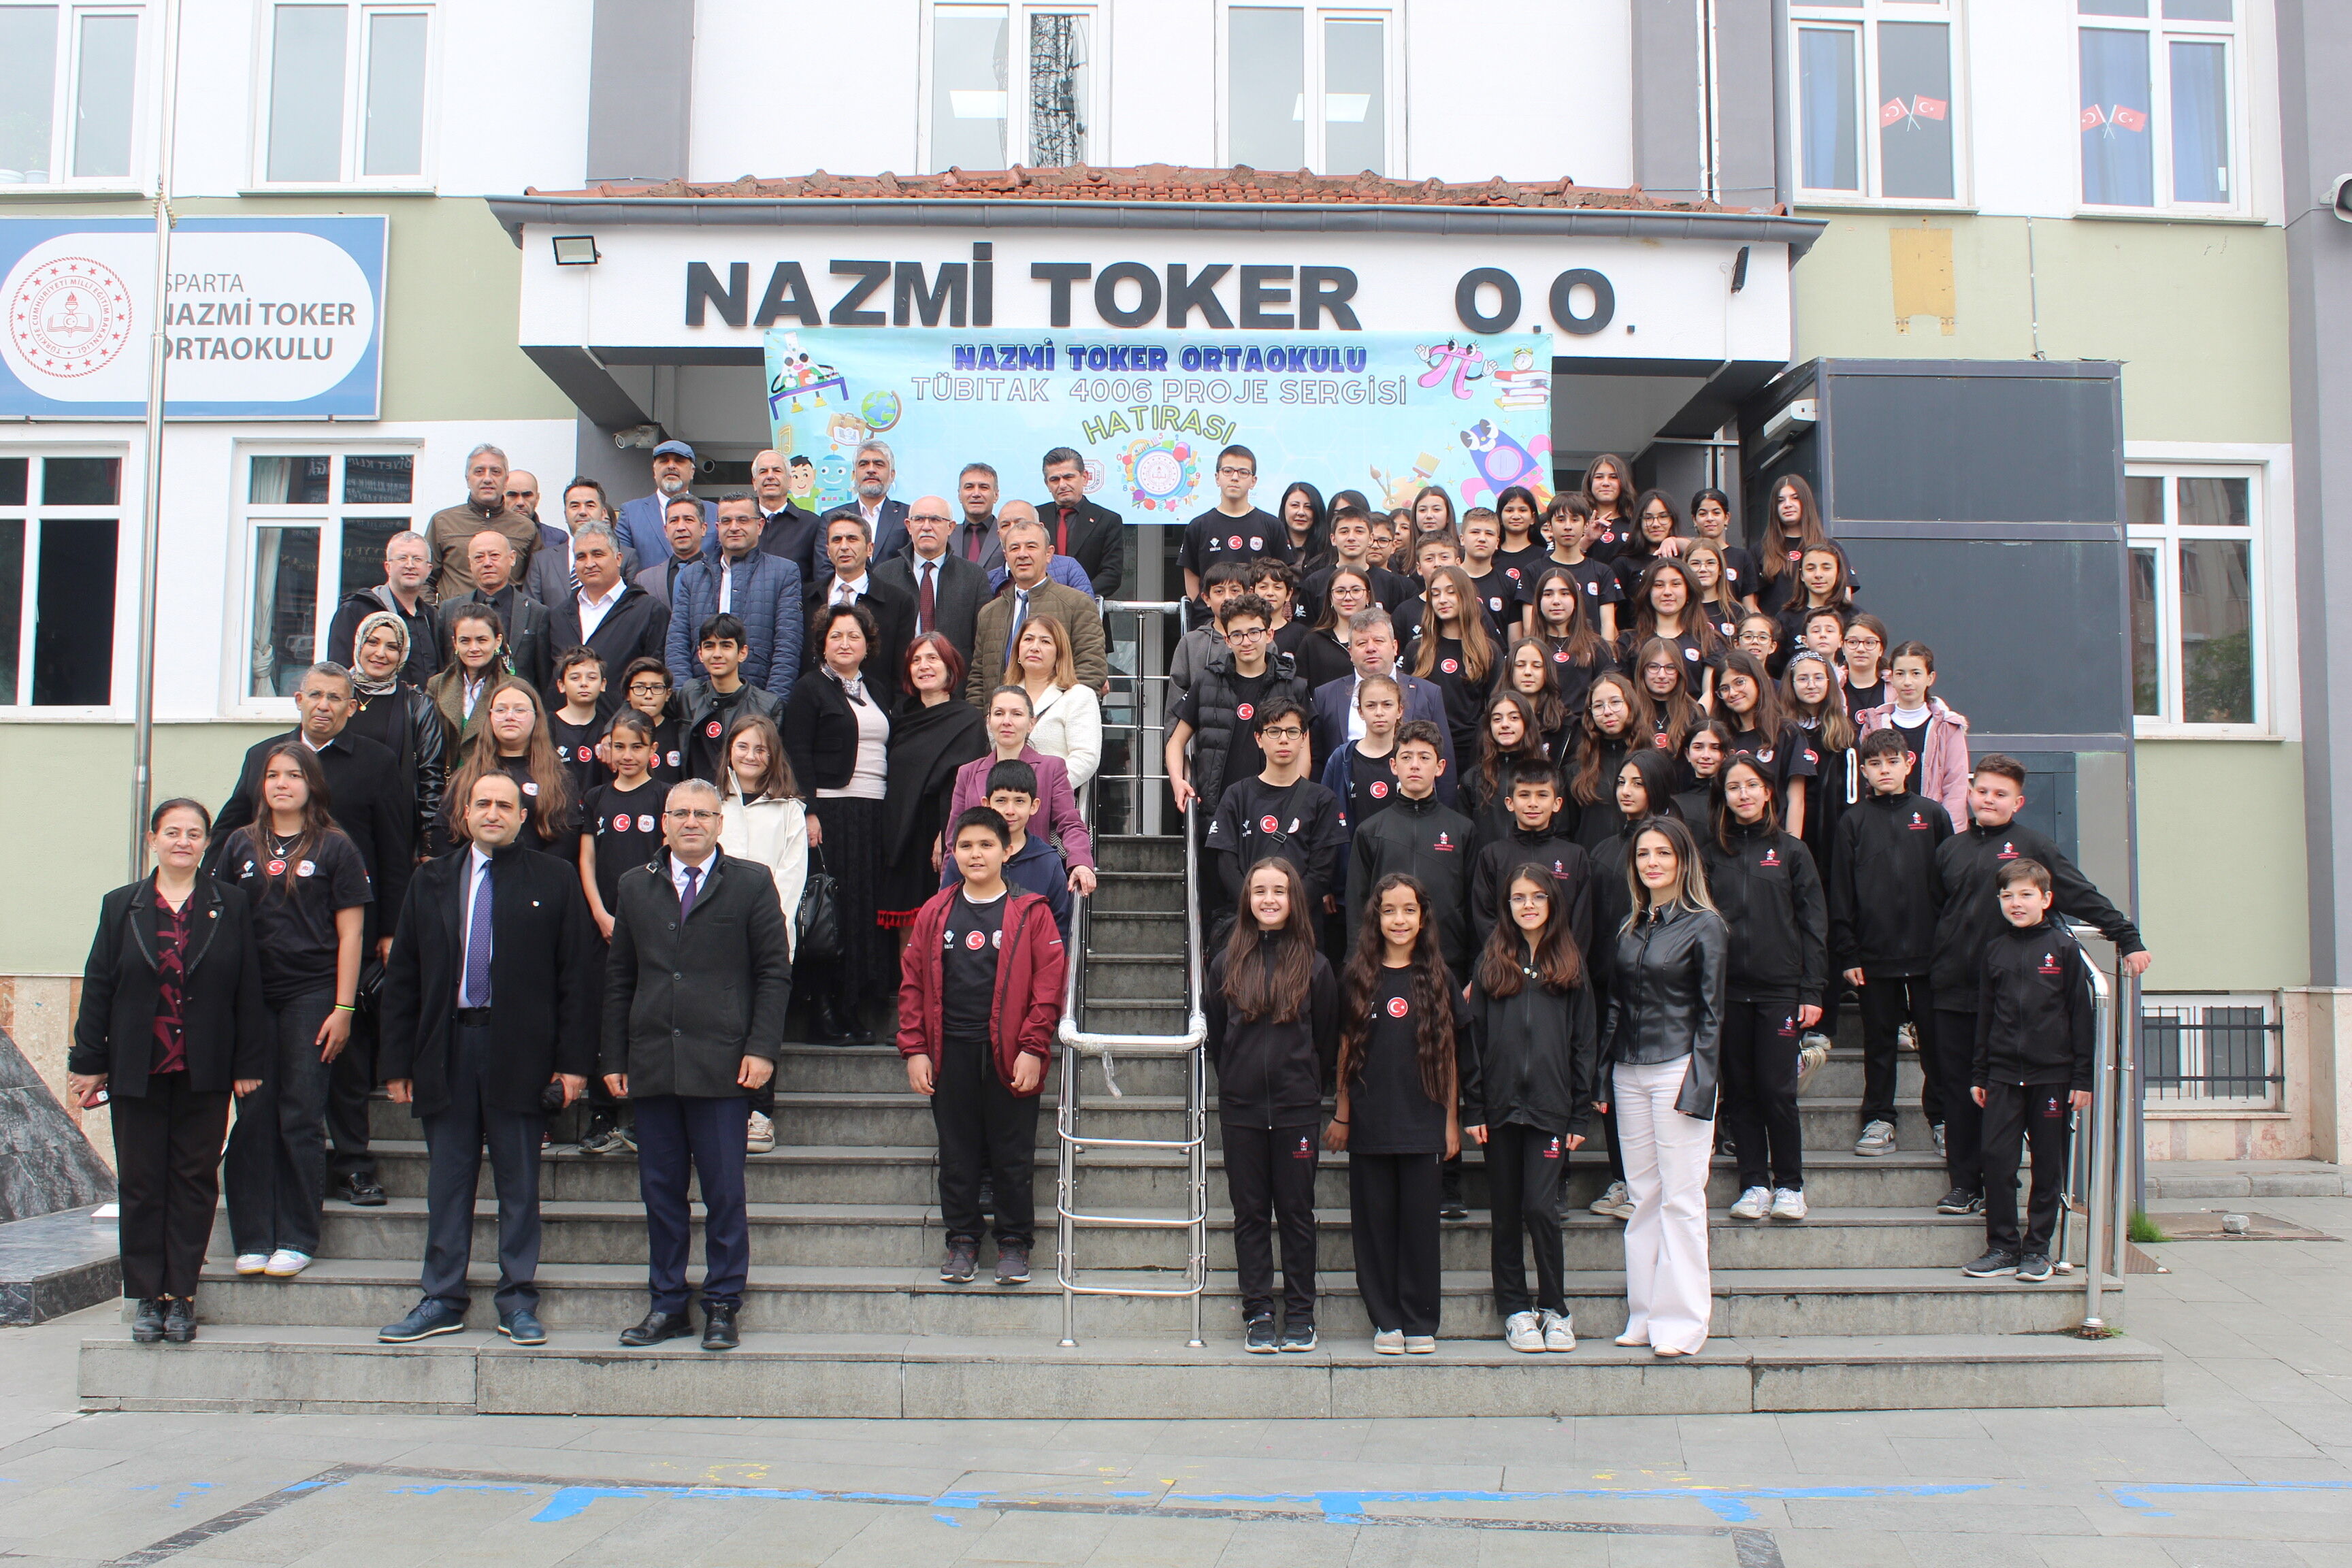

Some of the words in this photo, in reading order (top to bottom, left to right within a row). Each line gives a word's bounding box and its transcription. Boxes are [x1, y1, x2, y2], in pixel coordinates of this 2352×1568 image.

[685, 242, 993, 327] NAZMİ
[1030, 261, 1362, 331] TOKER
[259, 302, 355, 327] TOKER
[952, 338, 1056, 372] NAZMİ
[1065, 344, 1168, 372] TOKER
[1179, 345, 1367, 373] ORTAOKULU
[1069, 378, 1152, 403] 4006
[1162, 378, 1268, 404] PROJE
[1279, 375, 1407, 405] SERGİSİ
[1082, 404, 1237, 445] HATIRASI
